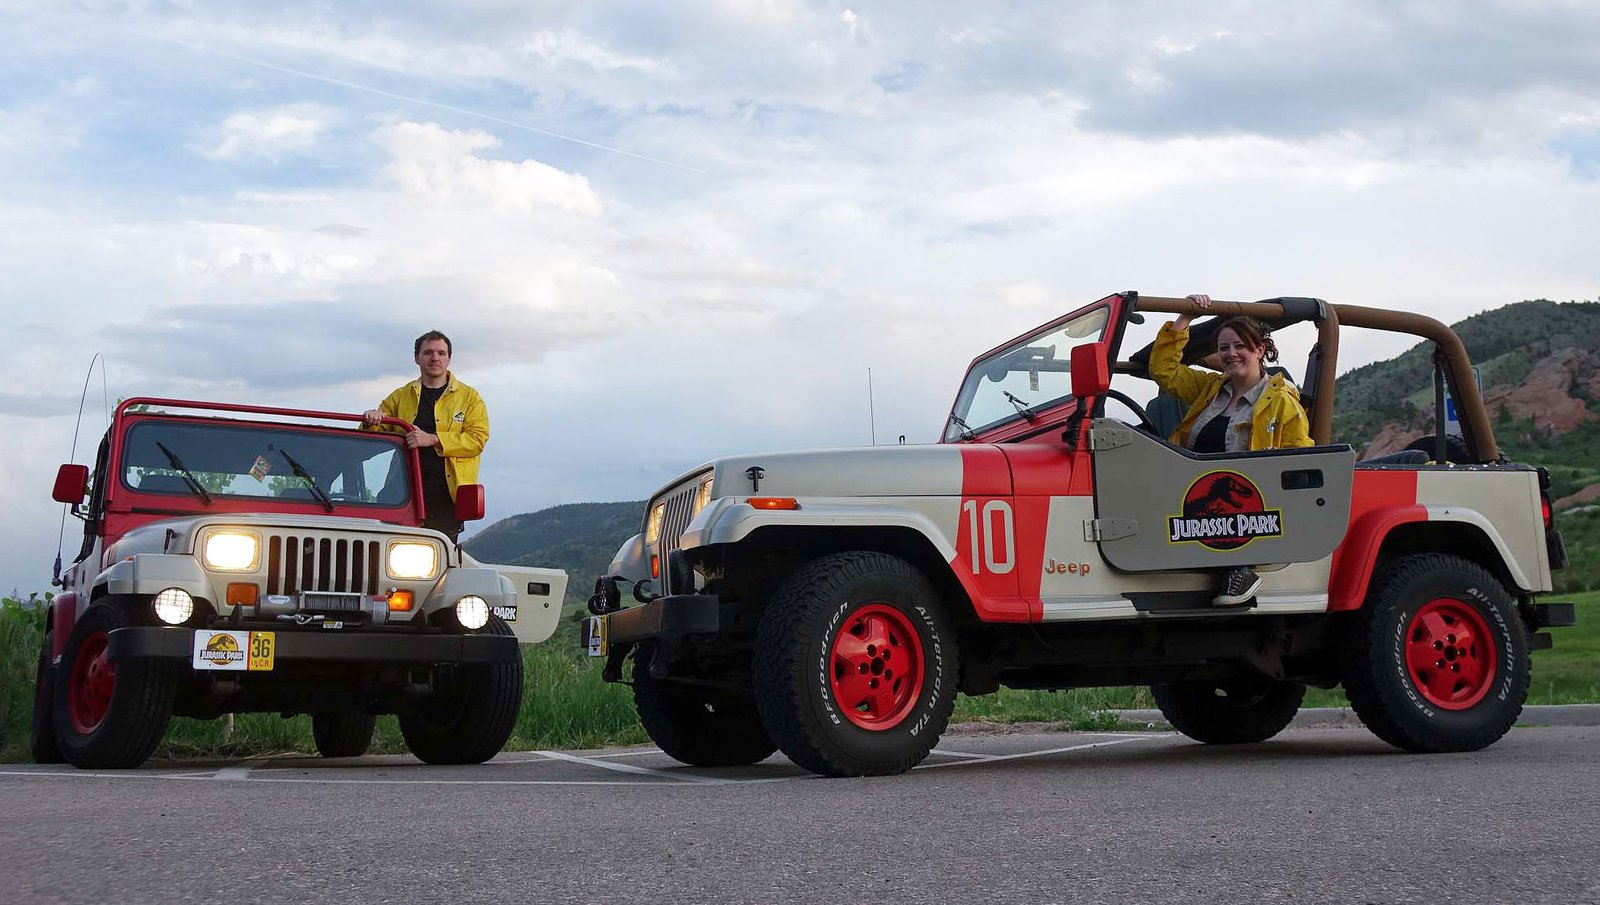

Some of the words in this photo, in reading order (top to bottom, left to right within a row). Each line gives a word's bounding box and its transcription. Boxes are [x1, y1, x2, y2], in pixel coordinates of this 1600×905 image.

[963, 499, 1016, 575] 10
[1172, 517, 1236, 541] JURASSIC
[1236, 513, 1280, 537] PARK
[1045, 558, 1090, 577] Jeep
[200, 650, 226, 661] JURASSIC
[226, 650, 243, 661] PARK
[251, 638, 270, 658] 36
[818, 601, 849, 726] BFGoodrich
[1394, 611, 1435, 718] BFGoodrich
